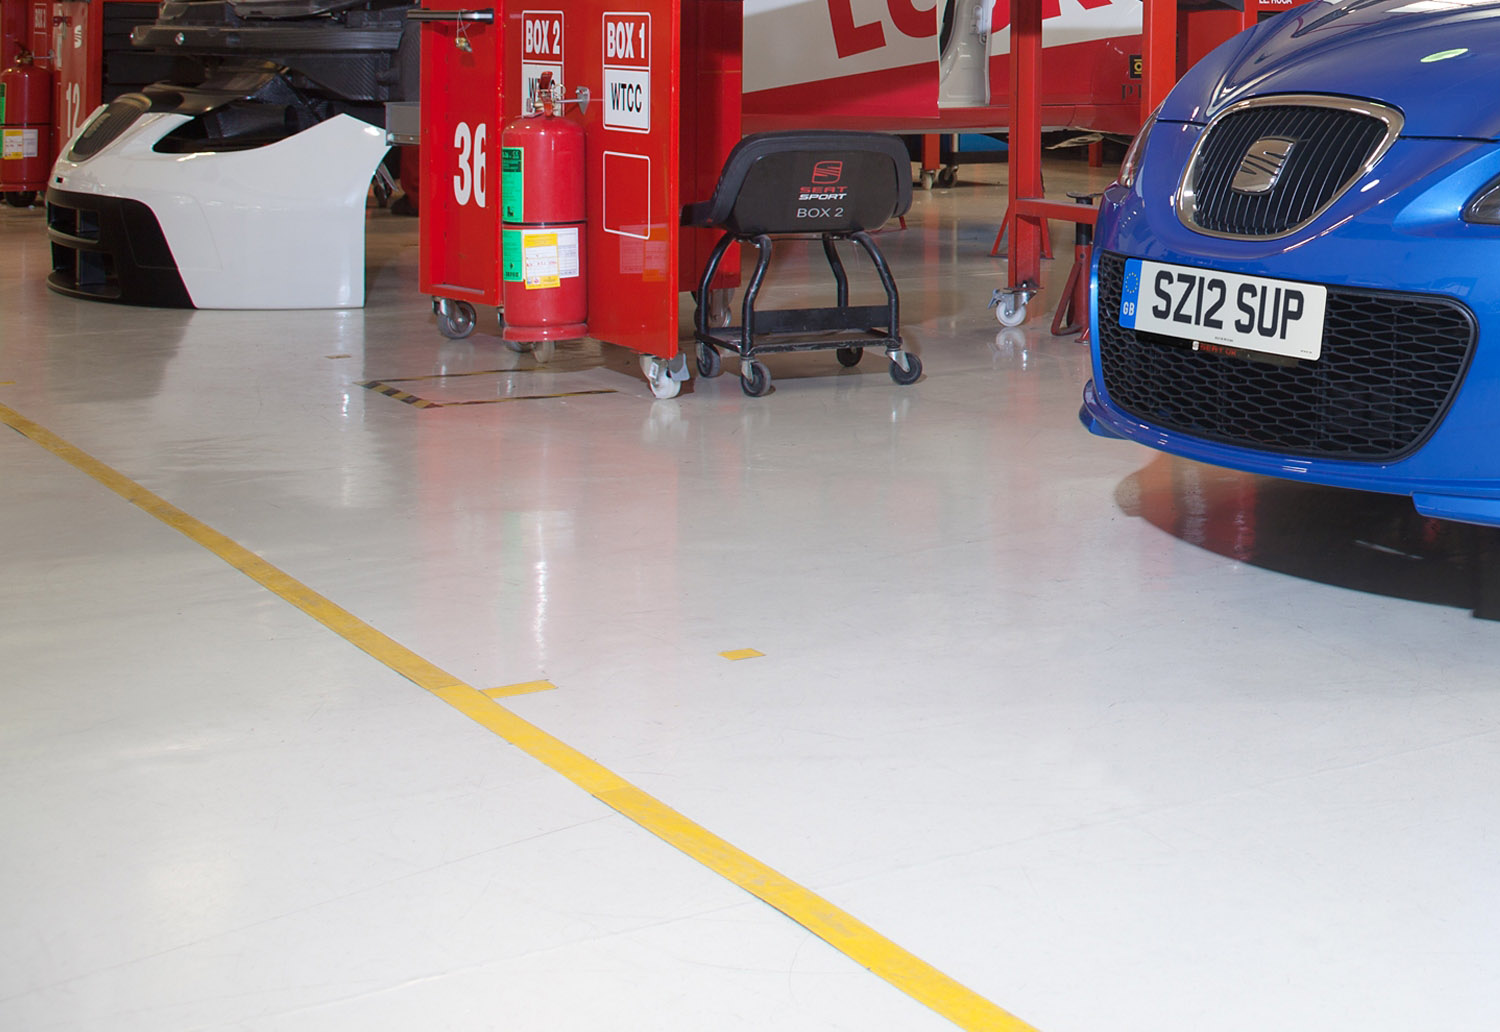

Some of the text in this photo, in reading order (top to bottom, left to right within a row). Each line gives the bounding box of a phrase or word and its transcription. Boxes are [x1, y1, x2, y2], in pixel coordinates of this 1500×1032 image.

[526, 19, 561, 55] BOX 2
[607, 21, 646, 59] BOX 1
[610, 82, 642, 113] WTCC
[796, 207, 844, 218] BOX 2
[798, 193, 847, 201] SPORT
[1122, 301, 1134, 316] GB
[1152, 270, 1304, 340] SZ12 SUP
